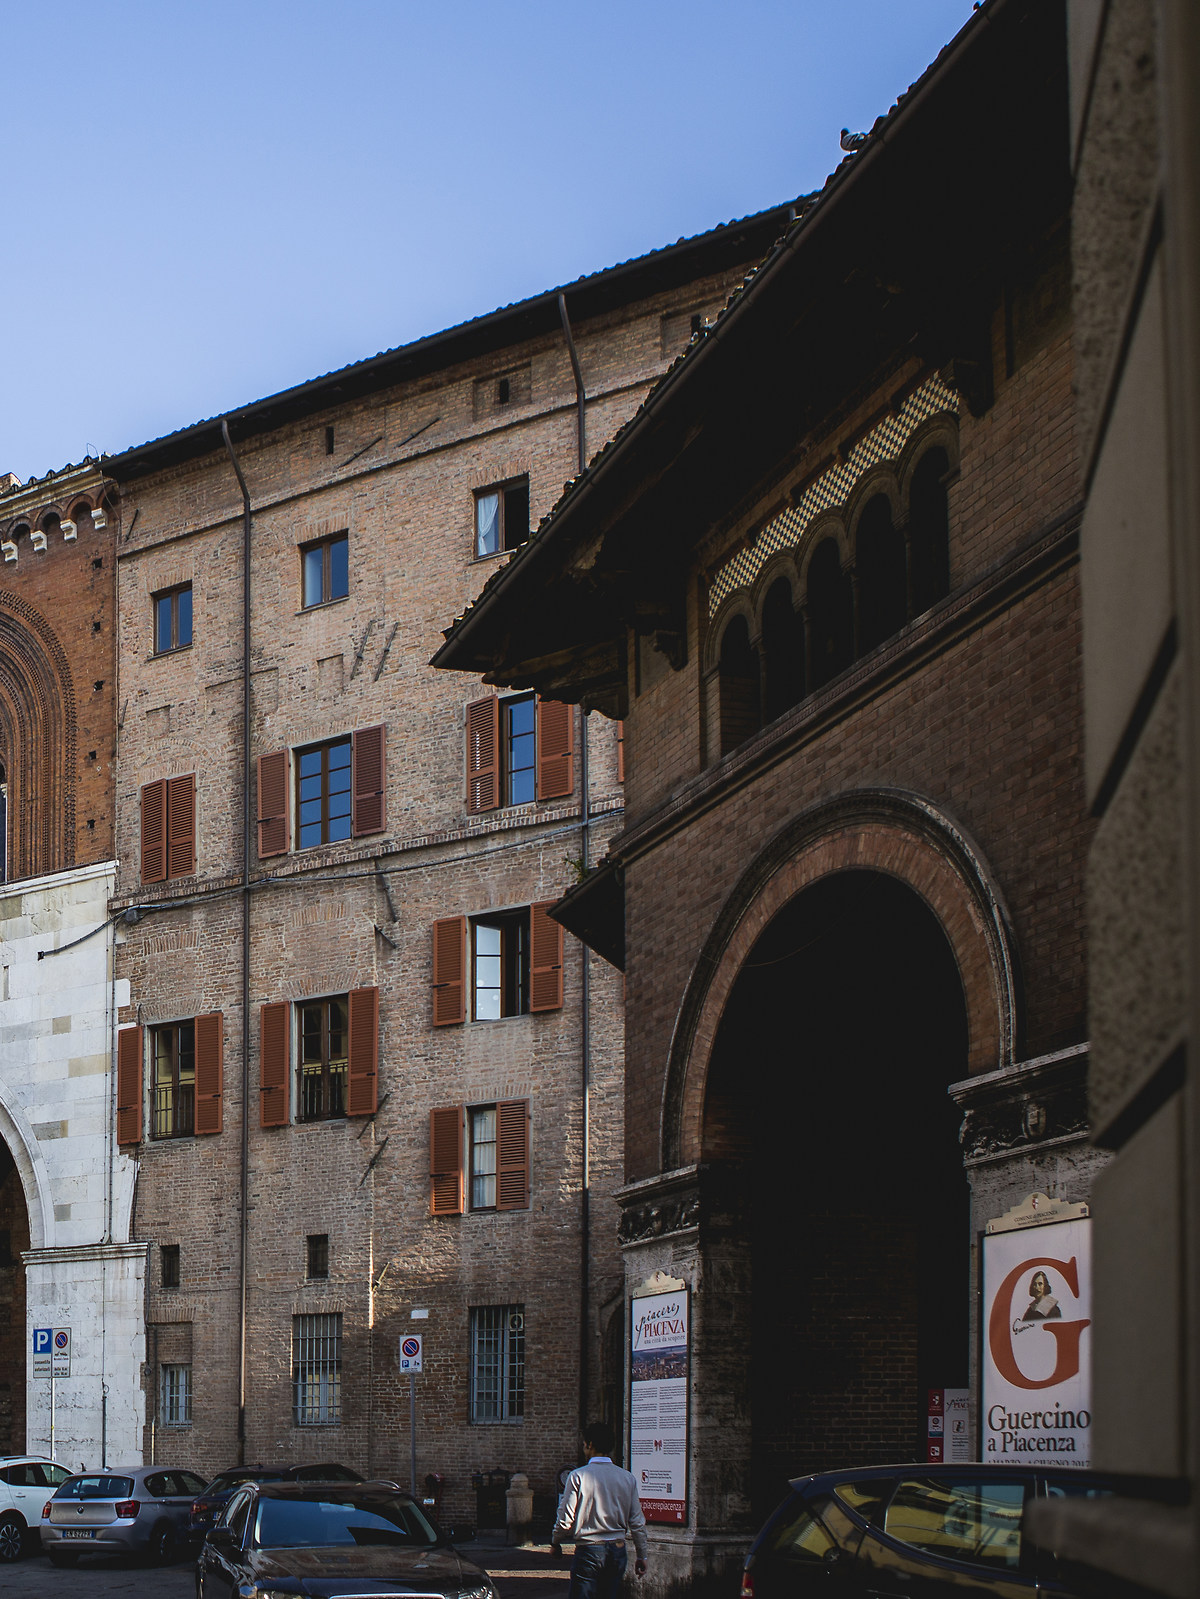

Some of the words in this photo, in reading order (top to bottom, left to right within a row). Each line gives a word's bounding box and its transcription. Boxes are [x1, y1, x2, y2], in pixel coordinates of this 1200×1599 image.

[644, 1320, 685, 1337] PIACENZA
[989, 1256, 1091, 1390] G
[37, 1331, 48, 1351] P
[988, 1402, 1091, 1431] Guercino
[988, 1437, 996, 1452] a
[1001, 1431, 1076, 1452] Piacenza
